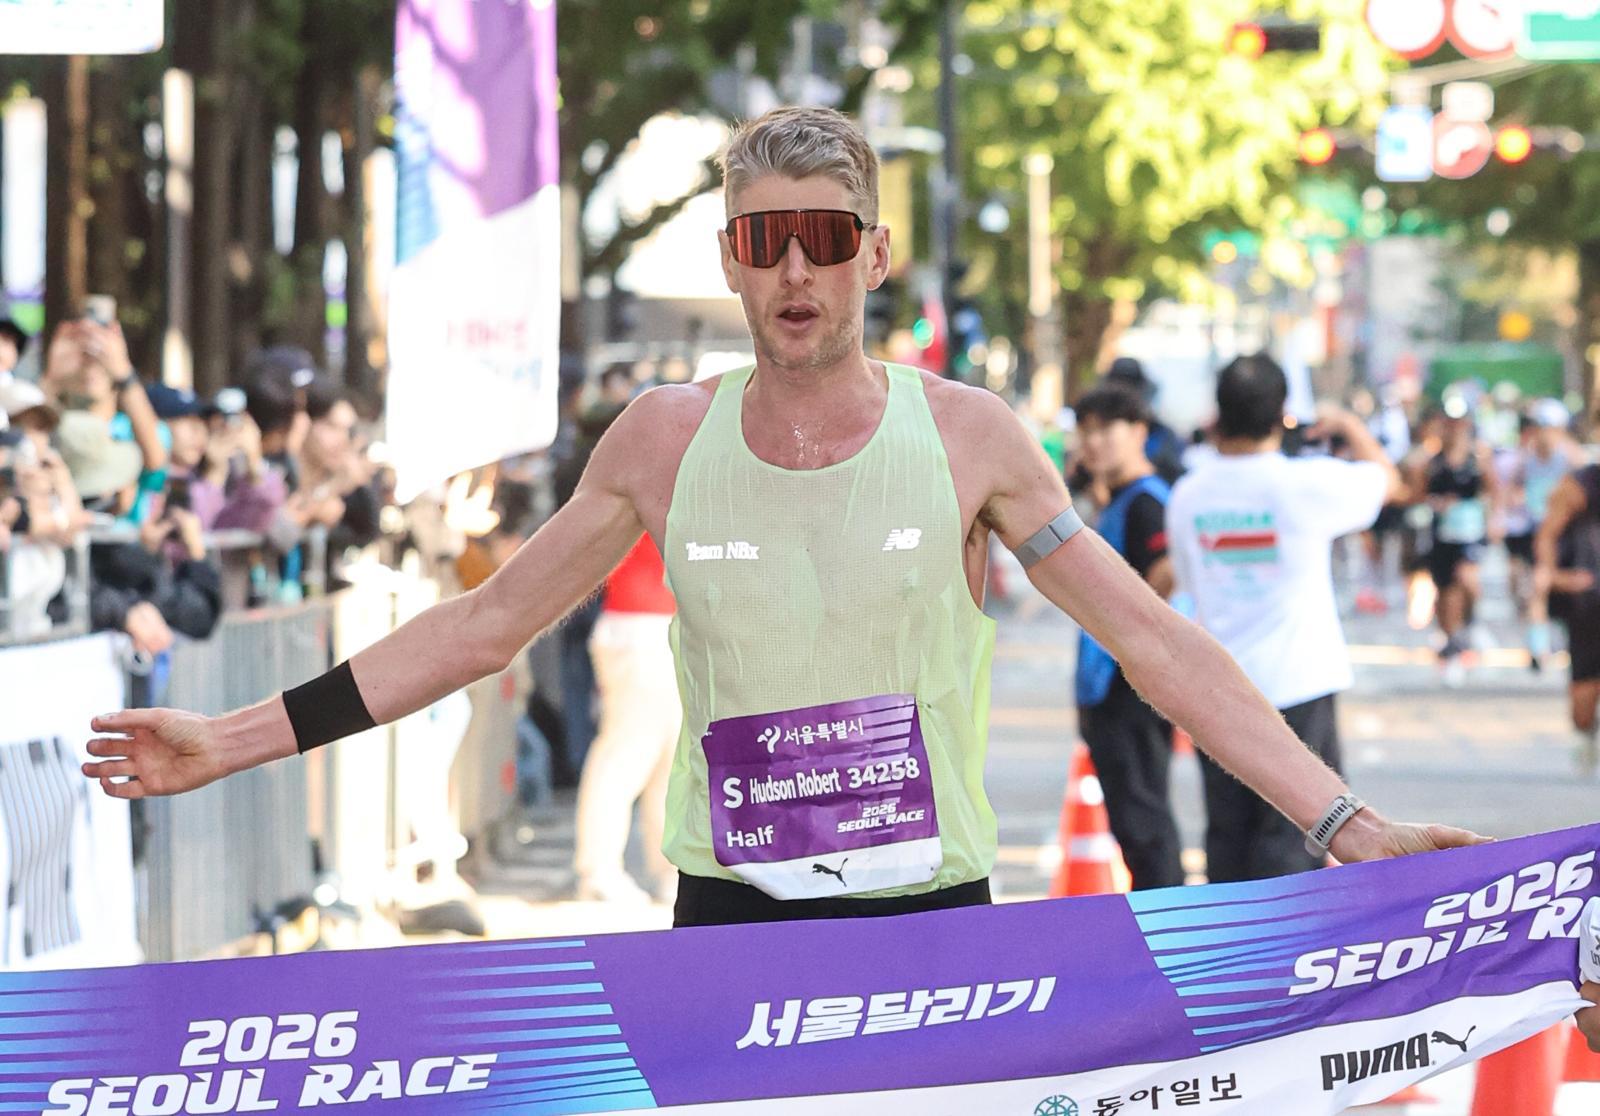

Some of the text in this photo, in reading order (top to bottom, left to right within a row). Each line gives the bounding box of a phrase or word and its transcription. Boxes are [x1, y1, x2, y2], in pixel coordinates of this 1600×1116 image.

[686, 541, 723, 561] Team
[783, 718, 864, 746] 서울특별시
[722, 757, 921, 809] S Hudson Robert 34258
[837, 809, 925, 833] SEOUL RACE
[862, 802, 897, 818] 2026
[726, 825, 774, 848] Half
[1424, 851, 1596, 928] 2026
[736, 976, 1056, 1050] 서울달리기
[180, 1010, 359, 1067] 2026
[1320, 1032, 1430, 1091] PUMA
[41, 1053, 498, 1116] SEOUL RACE
[1092, 1073, 1242, 1116] 동아일보
